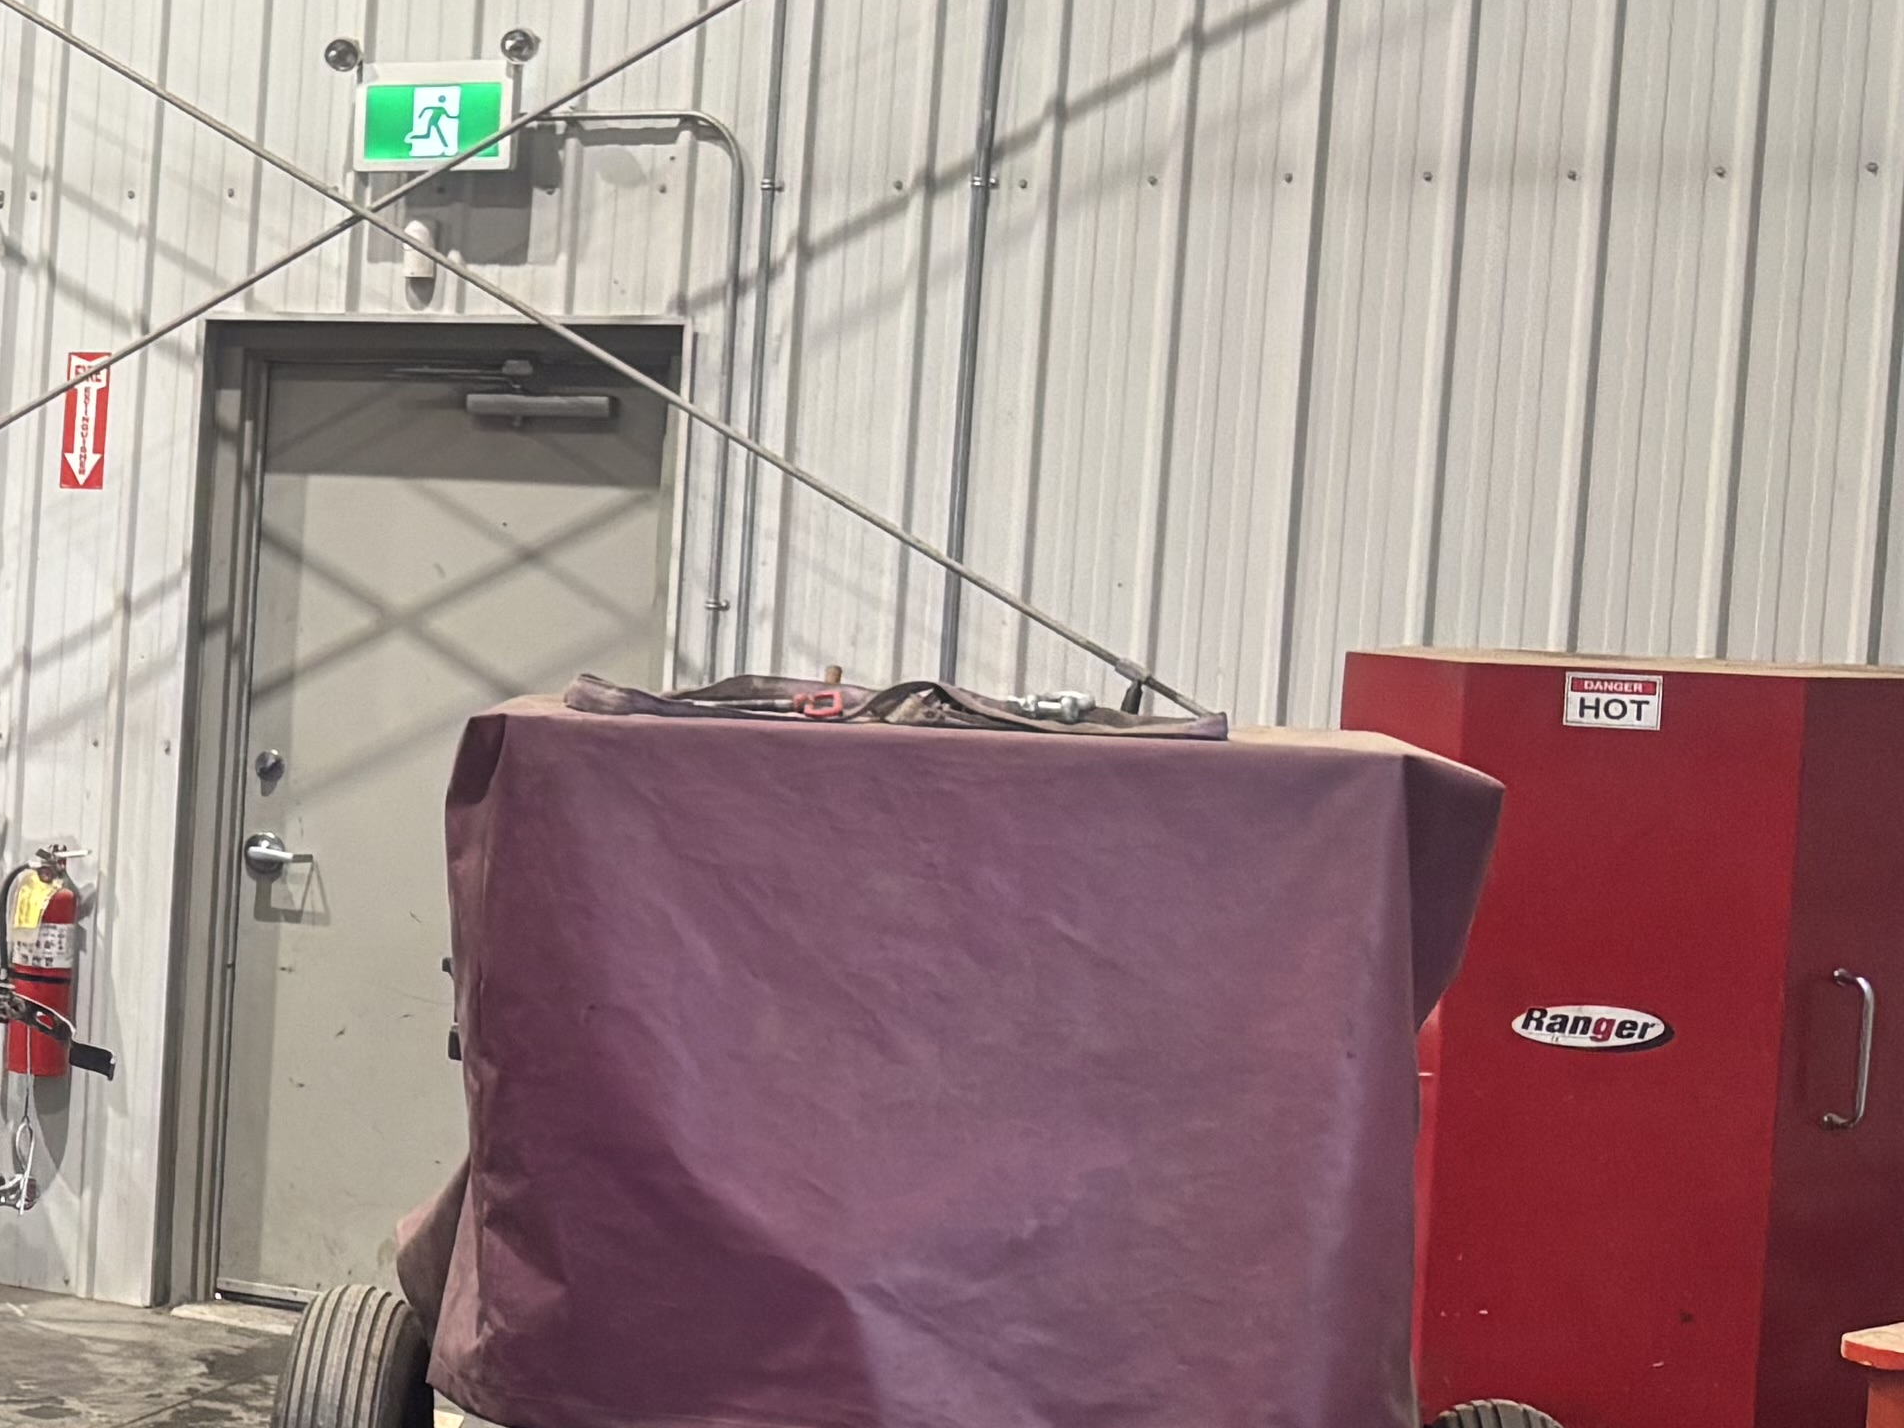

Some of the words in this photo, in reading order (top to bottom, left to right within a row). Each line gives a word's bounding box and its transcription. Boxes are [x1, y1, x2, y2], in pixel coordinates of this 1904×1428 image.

[1583, 680, 1643, 692] DANGER
[1579, 697, 1650, 721] HOT
[1521, 1008, 1656, 1042] Ranger
